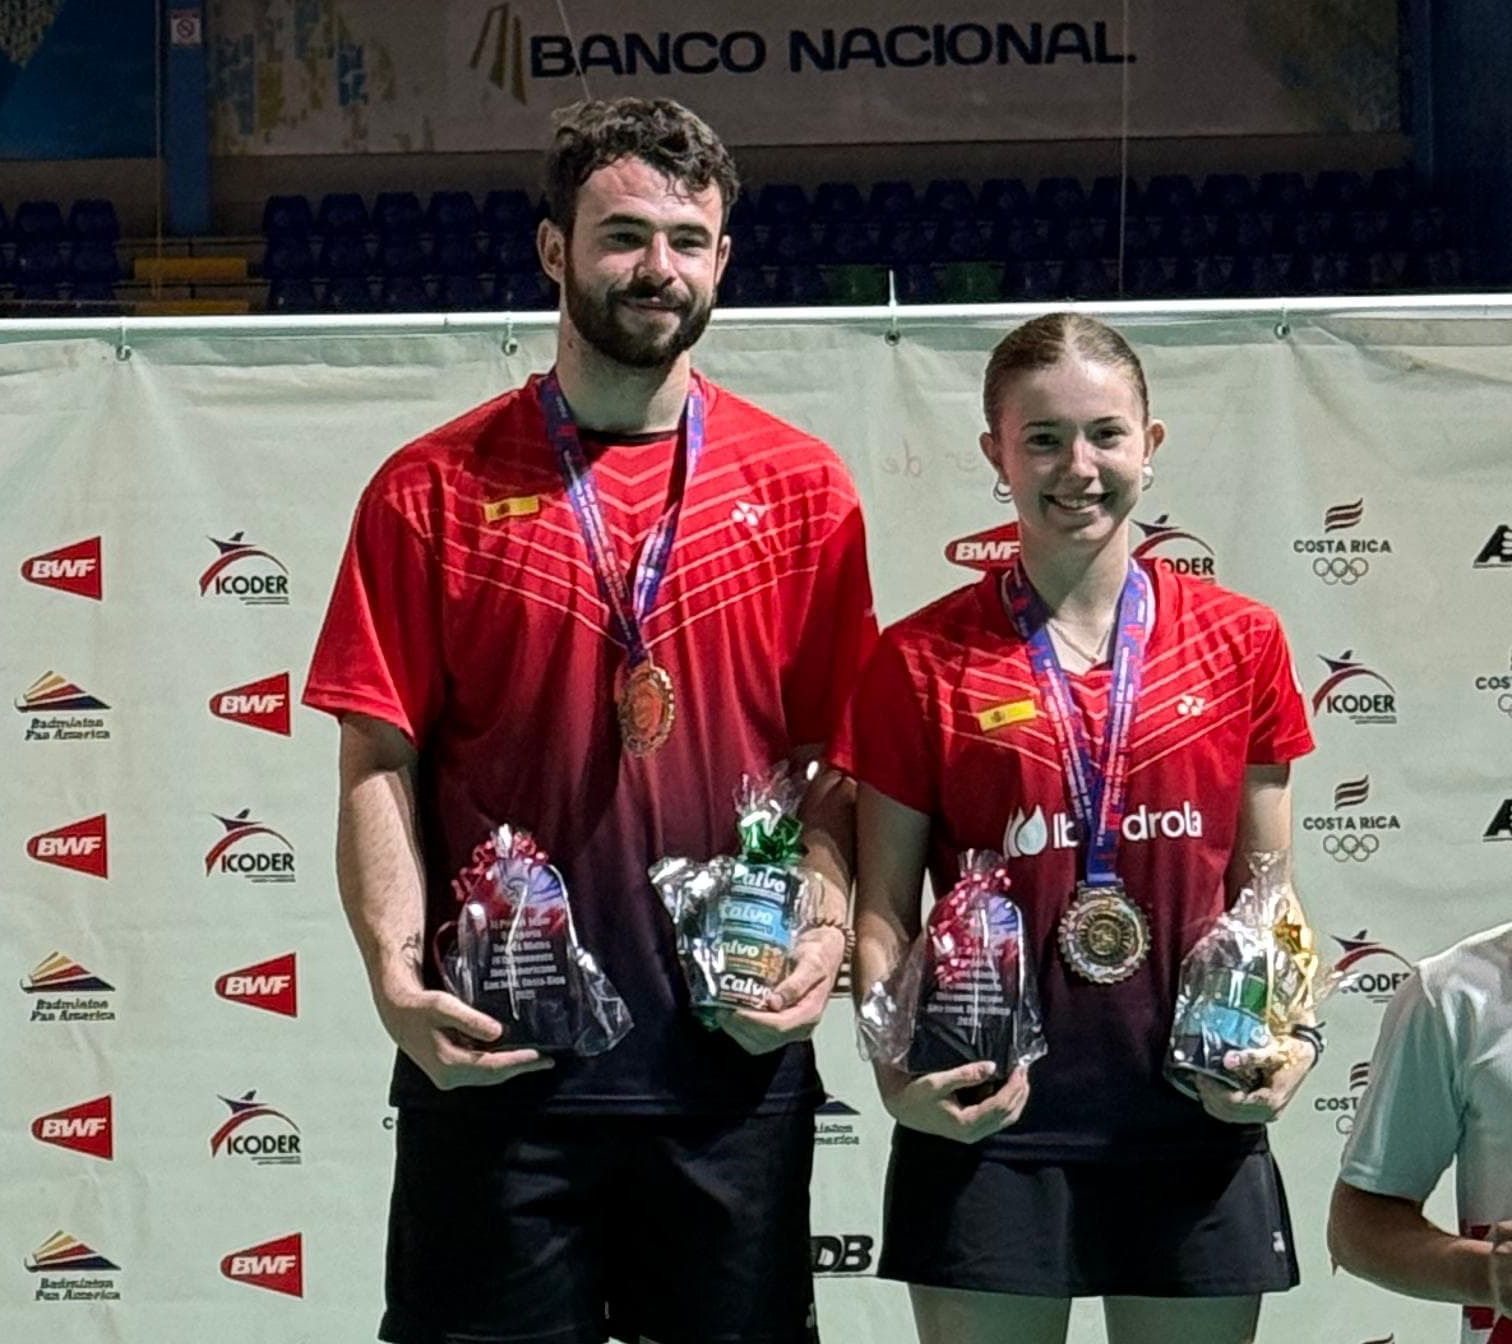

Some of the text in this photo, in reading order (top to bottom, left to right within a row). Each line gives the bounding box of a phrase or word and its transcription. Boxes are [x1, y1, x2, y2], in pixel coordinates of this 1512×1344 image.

[530, 20, 1137, 79] BANCO NACIONAL
[953, 541, 1022, 561] BWF
[1293, 539, 1392, 553] COSTA RICA
[30, 558, 97, 578] BWF
[1161, 557, 1215, 576] ODER
[215, 575, 289, 595] ICODER
[1475, 676, 1512, 690] COS
[218, 694, 285, 714] BWF
[1327, 694, 1396, 714] ICODER
[1053, 800, 1202, 849] Ibdrola
[1303, 815, 1401, 830] COSTA RICA
[36, 836, 102, 856] BWF
[221, 853, 295, 873] ICODER
[224, 975, 291, 996] BWF
[1314, 1097, 1358, 1111] COST
[41, 1117, 107, 1137] BWF
[226, 1135, 301, 1155] ICODER
[810, 1235, 874, 1273] DB
[230, 1255, 296, 1276] BWF
